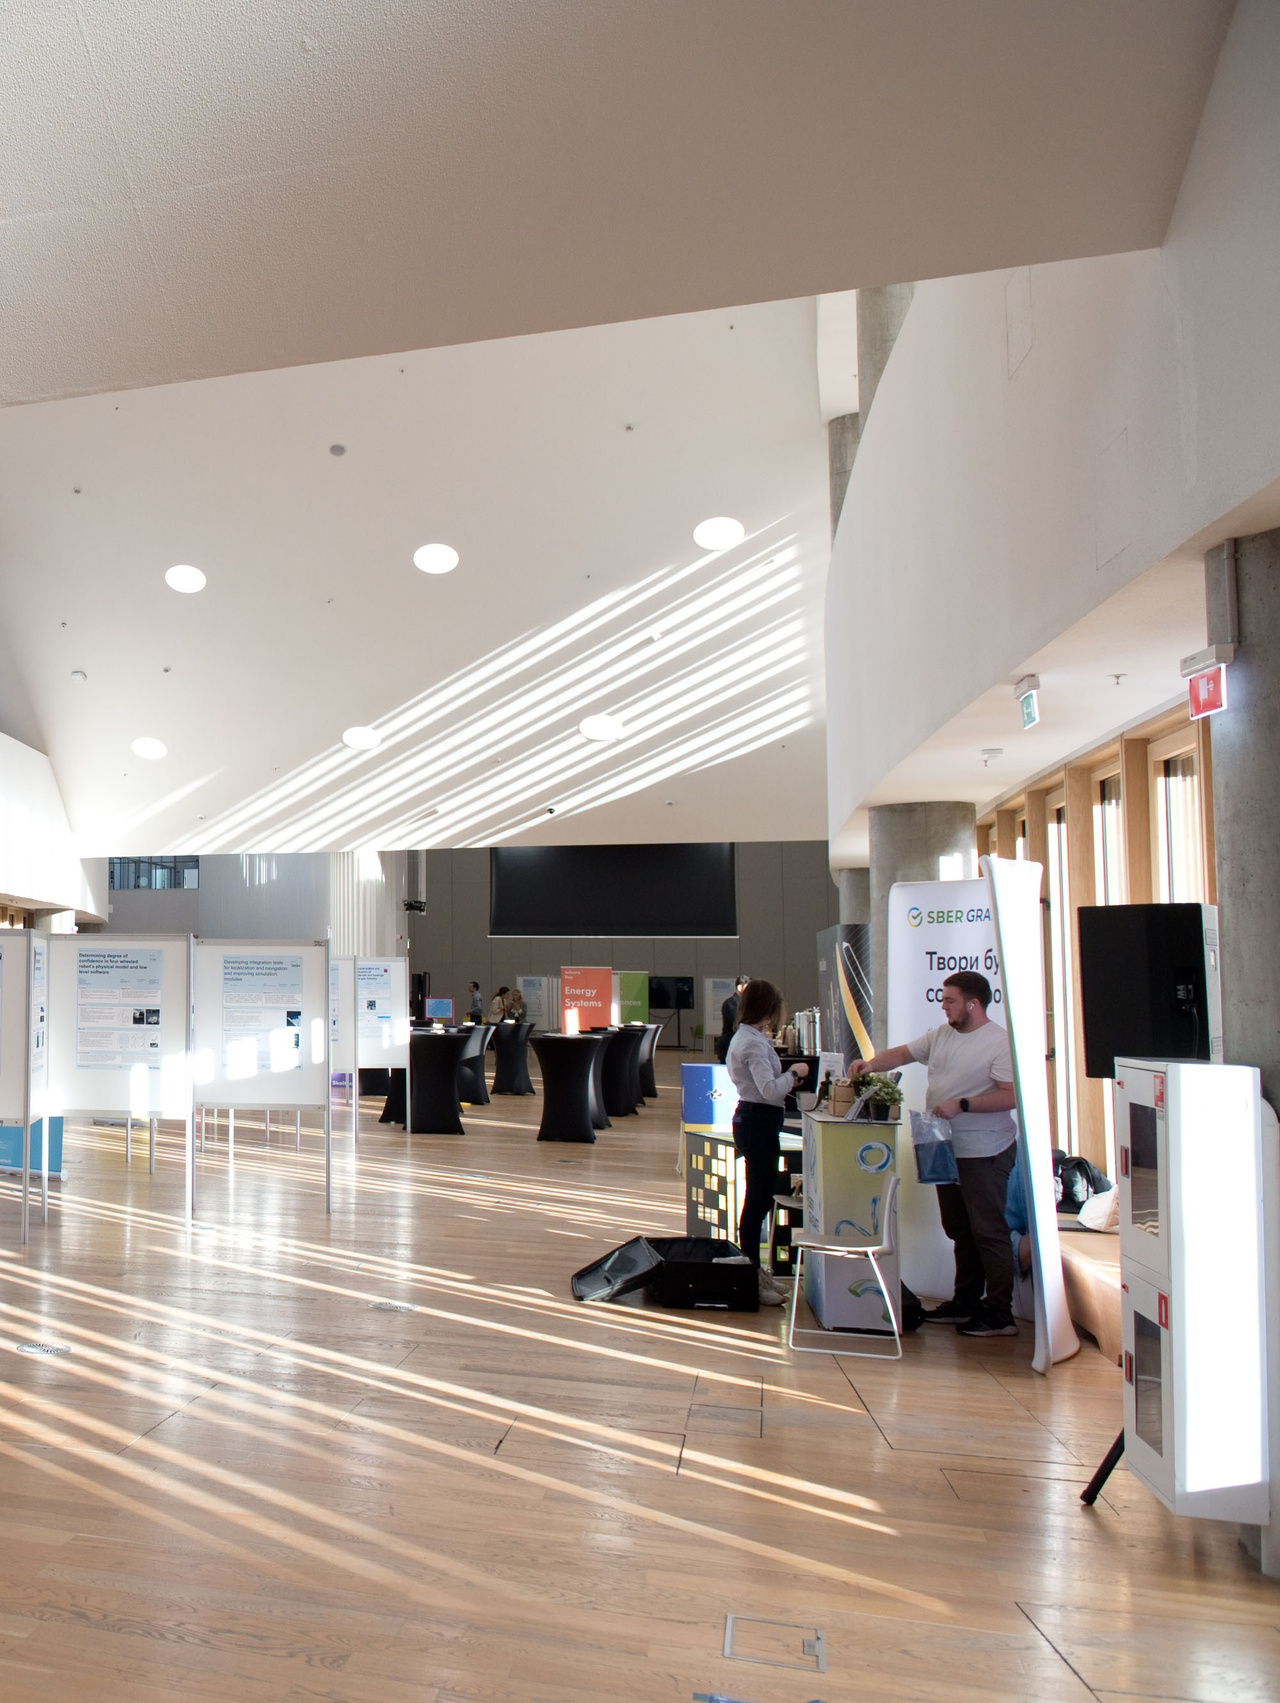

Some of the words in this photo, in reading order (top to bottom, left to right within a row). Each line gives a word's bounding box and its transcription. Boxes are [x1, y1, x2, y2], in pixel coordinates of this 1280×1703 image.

[927, 910, 963, 924] SBER
[966, 908, 991, 922] GRA
[925, 951, 979, 973] Твори
[565, 987, 597, 997] Energy
[565, 999, 602, 1008] Systems
